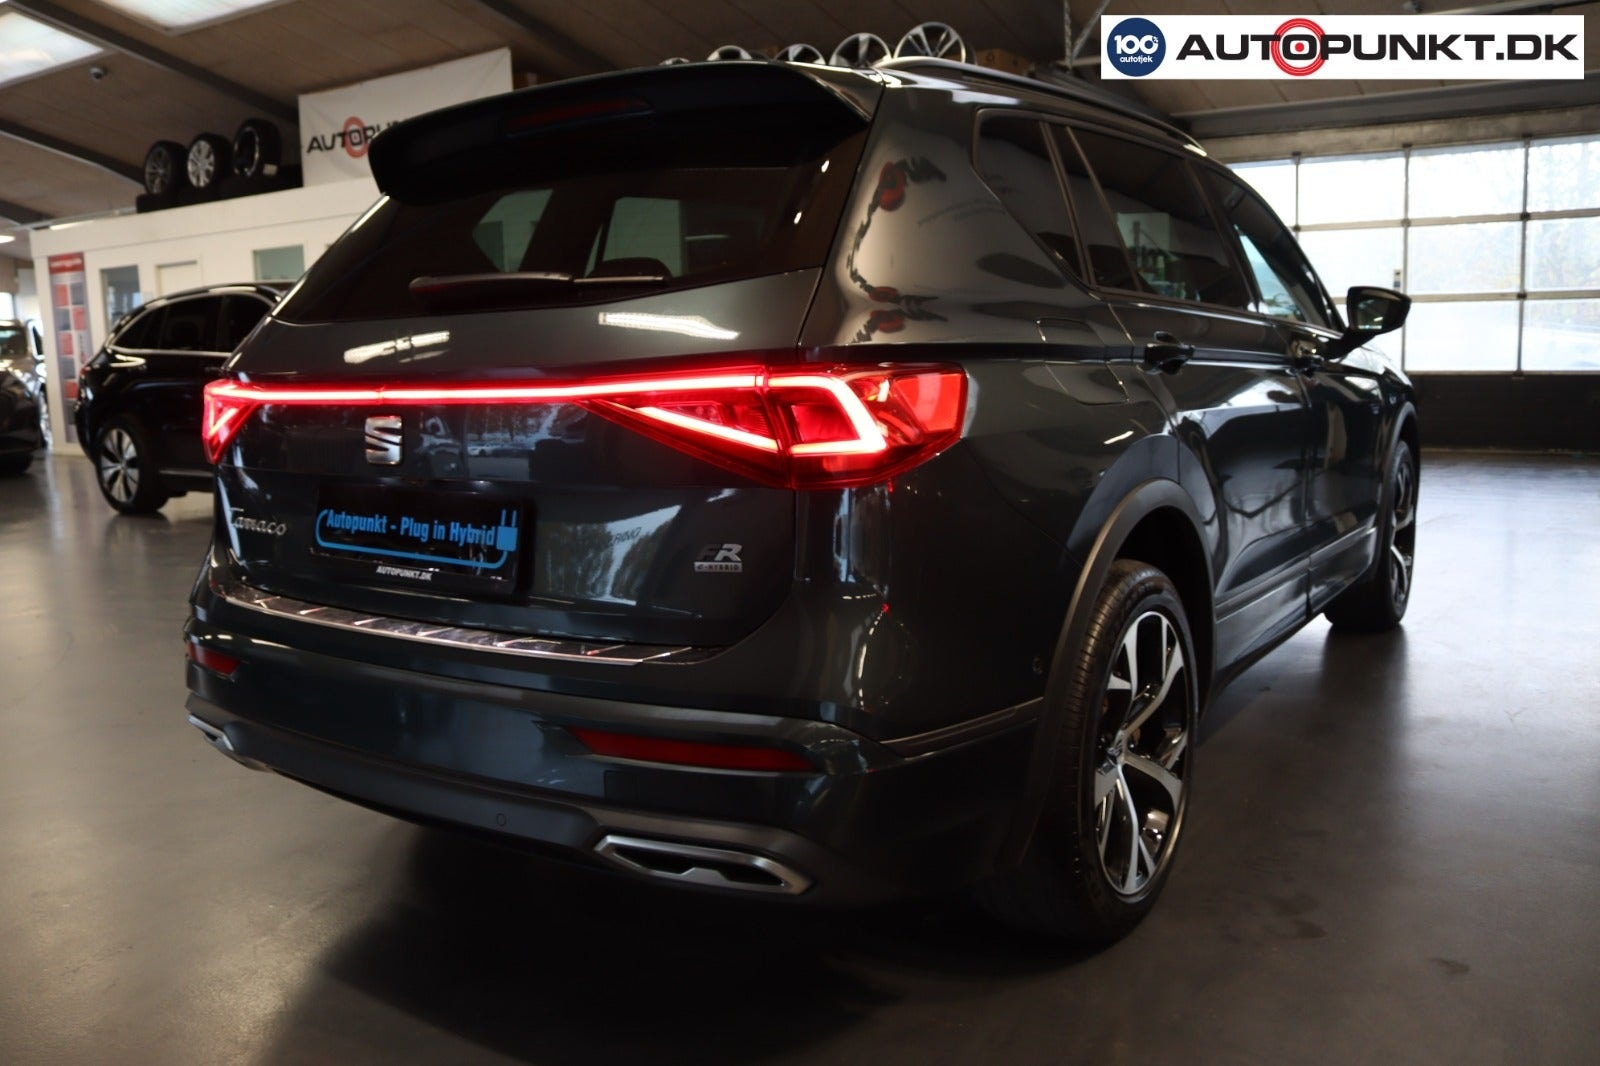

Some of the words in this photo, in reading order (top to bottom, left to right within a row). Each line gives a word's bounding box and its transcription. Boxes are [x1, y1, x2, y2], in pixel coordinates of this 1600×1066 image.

[326, 508, 388, 535] Autopunkt
[400, 516, 430, 543] Plug
[433, 520, 446, 541] in
[449, 520, 496, 548] Hybrid
[695, 543, 743, 561] FR
[375, 564, 434, 582] AUTOPUNKT.DK
